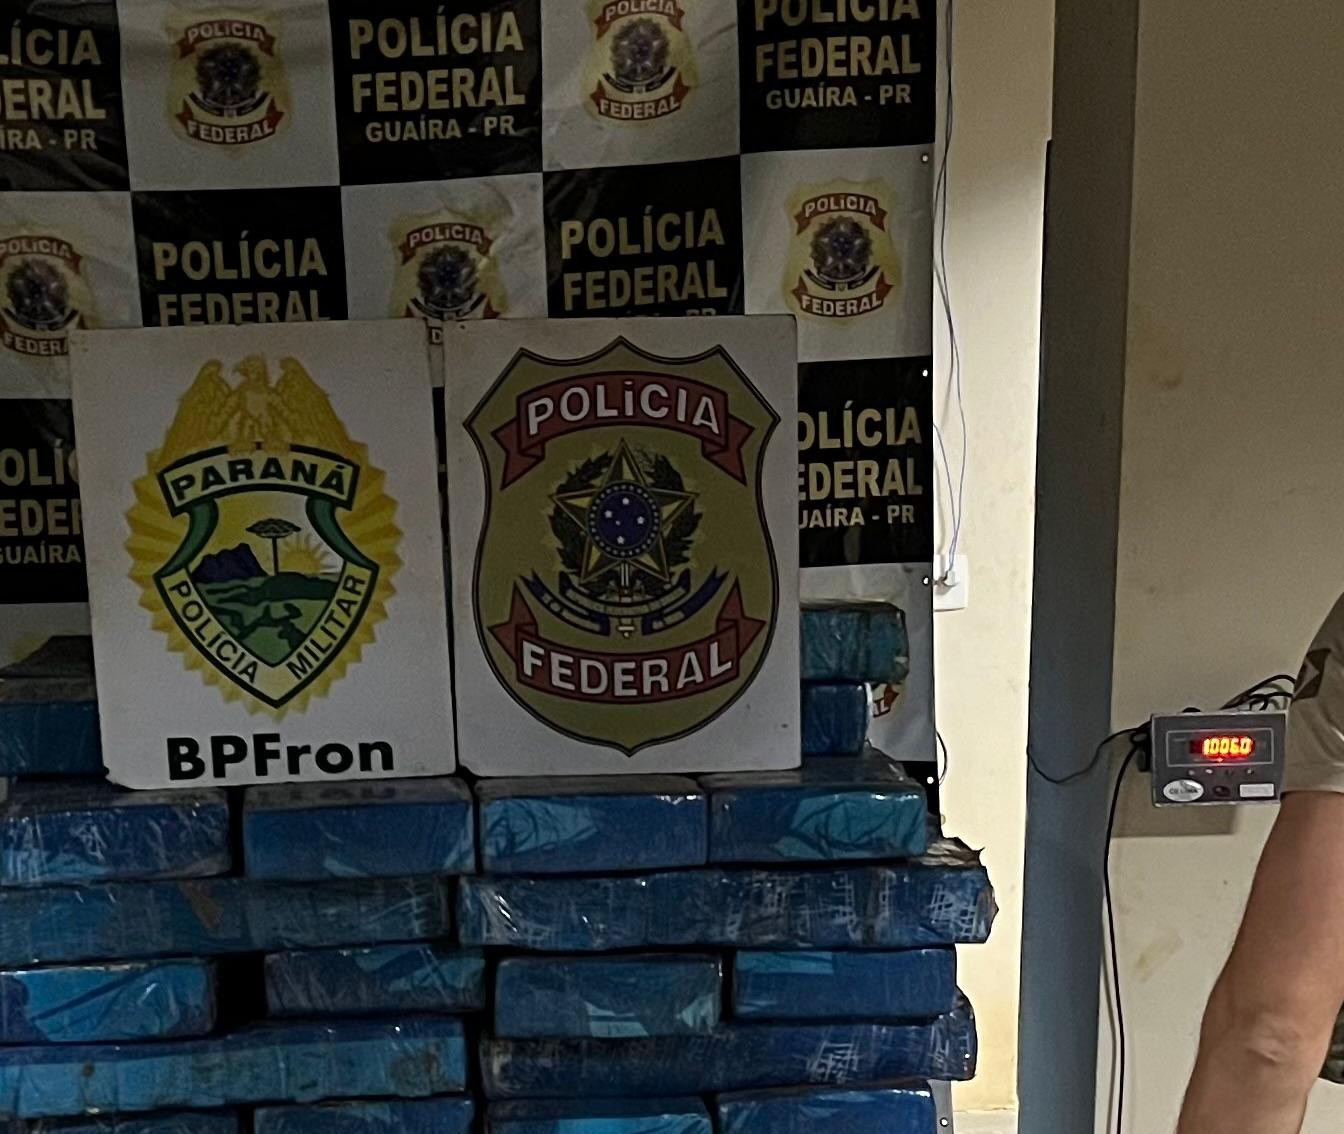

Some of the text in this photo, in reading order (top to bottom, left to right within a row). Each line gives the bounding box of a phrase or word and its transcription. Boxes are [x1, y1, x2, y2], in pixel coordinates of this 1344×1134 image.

[348, 4, 524, 60] POLÍCIA
[755, 33, 922, 83] FEDERAL
[352, 65, 526, 112] FEDERAL
[600, 96, 680, 118] FEDERAL
[765, 81, 857, 110] GUAÍRA
[879, 83, 912, 106] PR
[64, 129, 98, 150] PR
[186, 122, 274, 144] FEDERAL
[365, 114, 462, 143] GUAÍRA
[483, 115, 516, 137] PR
[561, 205, 727, 259] POLÍCIA
[153, 230, 328, 282] POLÍCIA
[158, 289, 331, 327] FEDERAL
[563, 259, 729, 312] FEDERAL
[802, 292, 882, 317] FEDERAL
[170, 457, 345, 500] PARANÁ
[887, 504, 915, 524] PR
[286, 574, 365, 681] MILITAR
[522, 641, 733, 697] FEDERAL
[167, 733, 394, 781] BPFron
